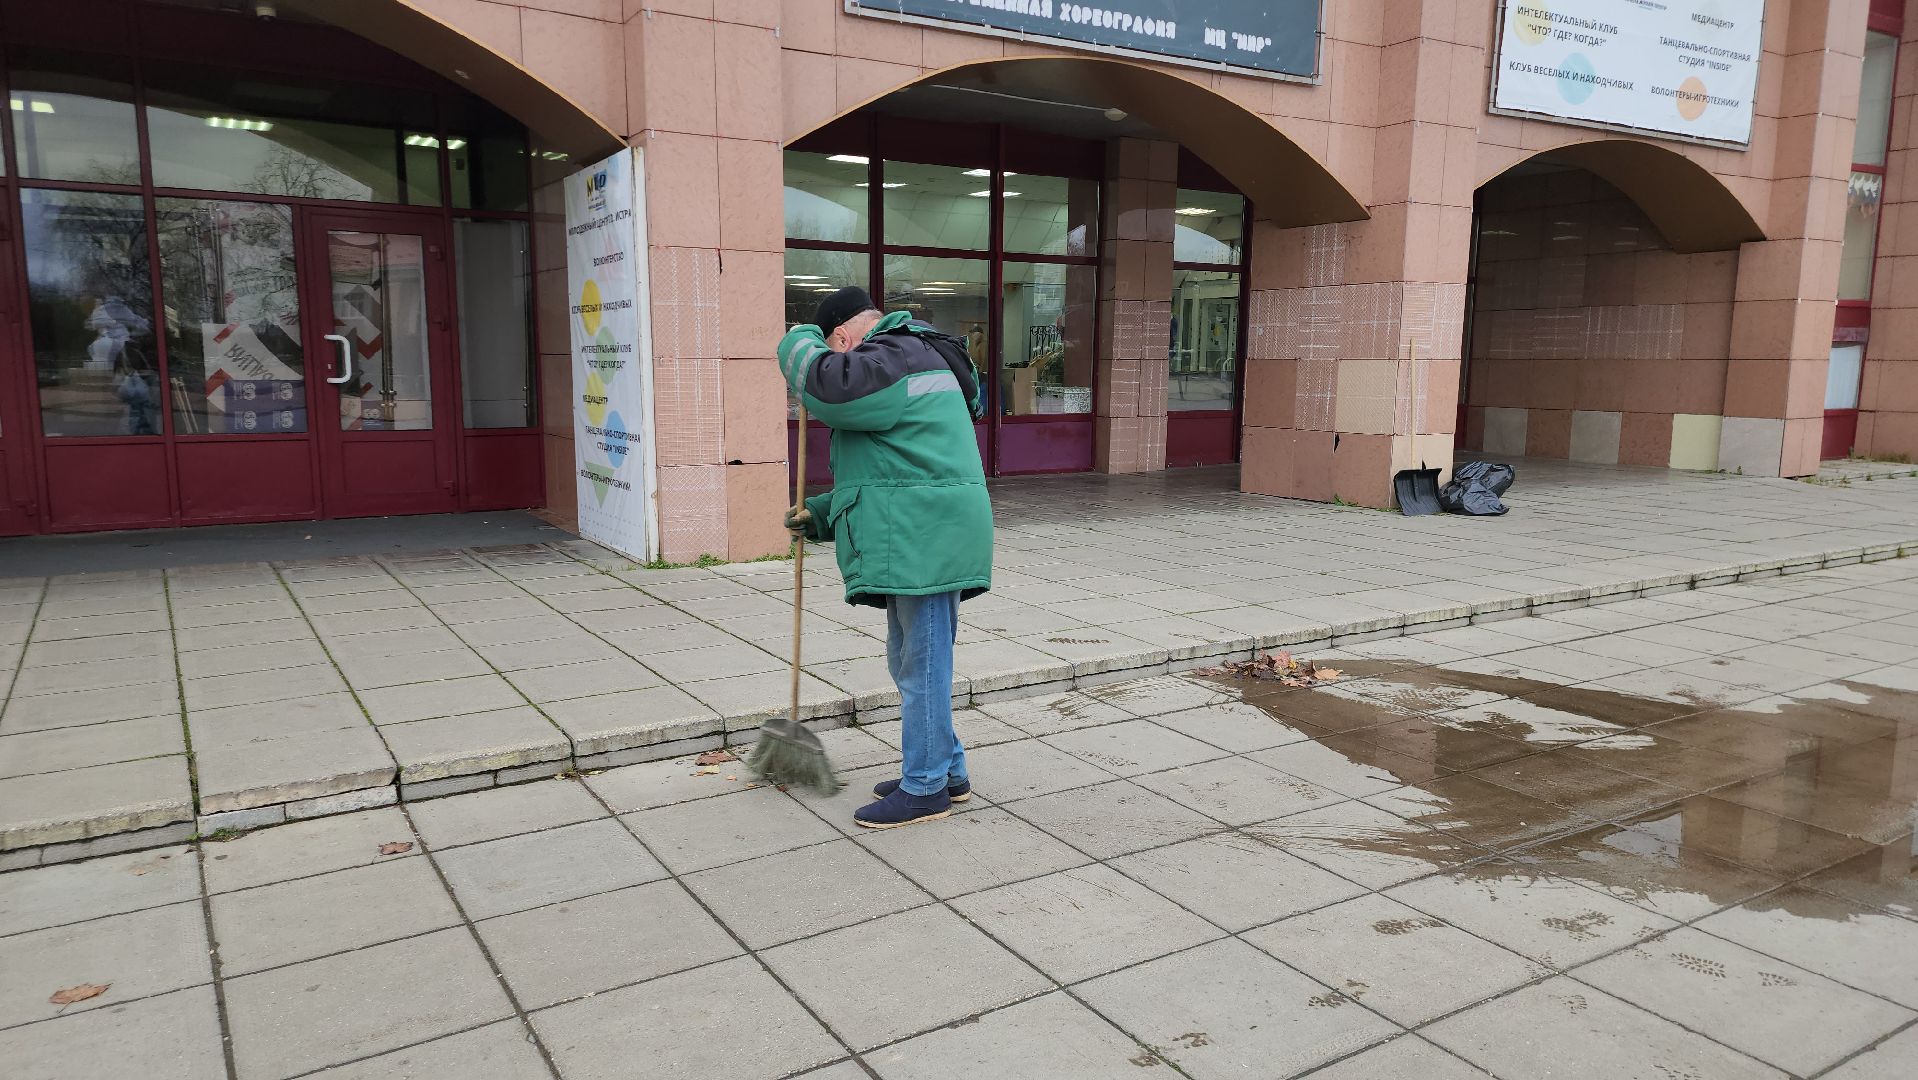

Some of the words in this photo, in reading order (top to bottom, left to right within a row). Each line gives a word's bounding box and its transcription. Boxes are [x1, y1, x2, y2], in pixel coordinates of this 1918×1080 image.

[1060, 3, 1176, 39] ХОРЕОГРАФИЯ
[1517, 5, 1597, 31] ИНТЕЛЕКТУАЛЬНЫЙ
[1599, 22, 1619, 35] КЛУБ
[1691, 12, 1735, 30] МЕДИАЦЕНТР
[1204, 27, 1226, 50] МЦ
[1527, 24, 1552, 36] "ЧТО?
[1553, 29, 1573, 42] ГДЕ?
[1573, 33, 1607, 47] КОГДА?"
[1659, 36, 1752, 62] ТАНЦЕВАЛЬНО-СПОРТИВНАЯ
[1678, 55, 1705, 68] СТУДИЯ
[1706, 60, 1733, 72] "INSIDE"
[1509, 61, 1533, 73] КЛУБ
[1533, 65, 1570, 80] ВЕСЕЛЫХ
[1572, 72, 1579, 81] И
[1579, 73, 1635, 90] НАХОДЧИВЫХ
[1651, 86, 1740, 108] ВОЛОНТЕРЫ-ИГРОТЕХНИКИ
